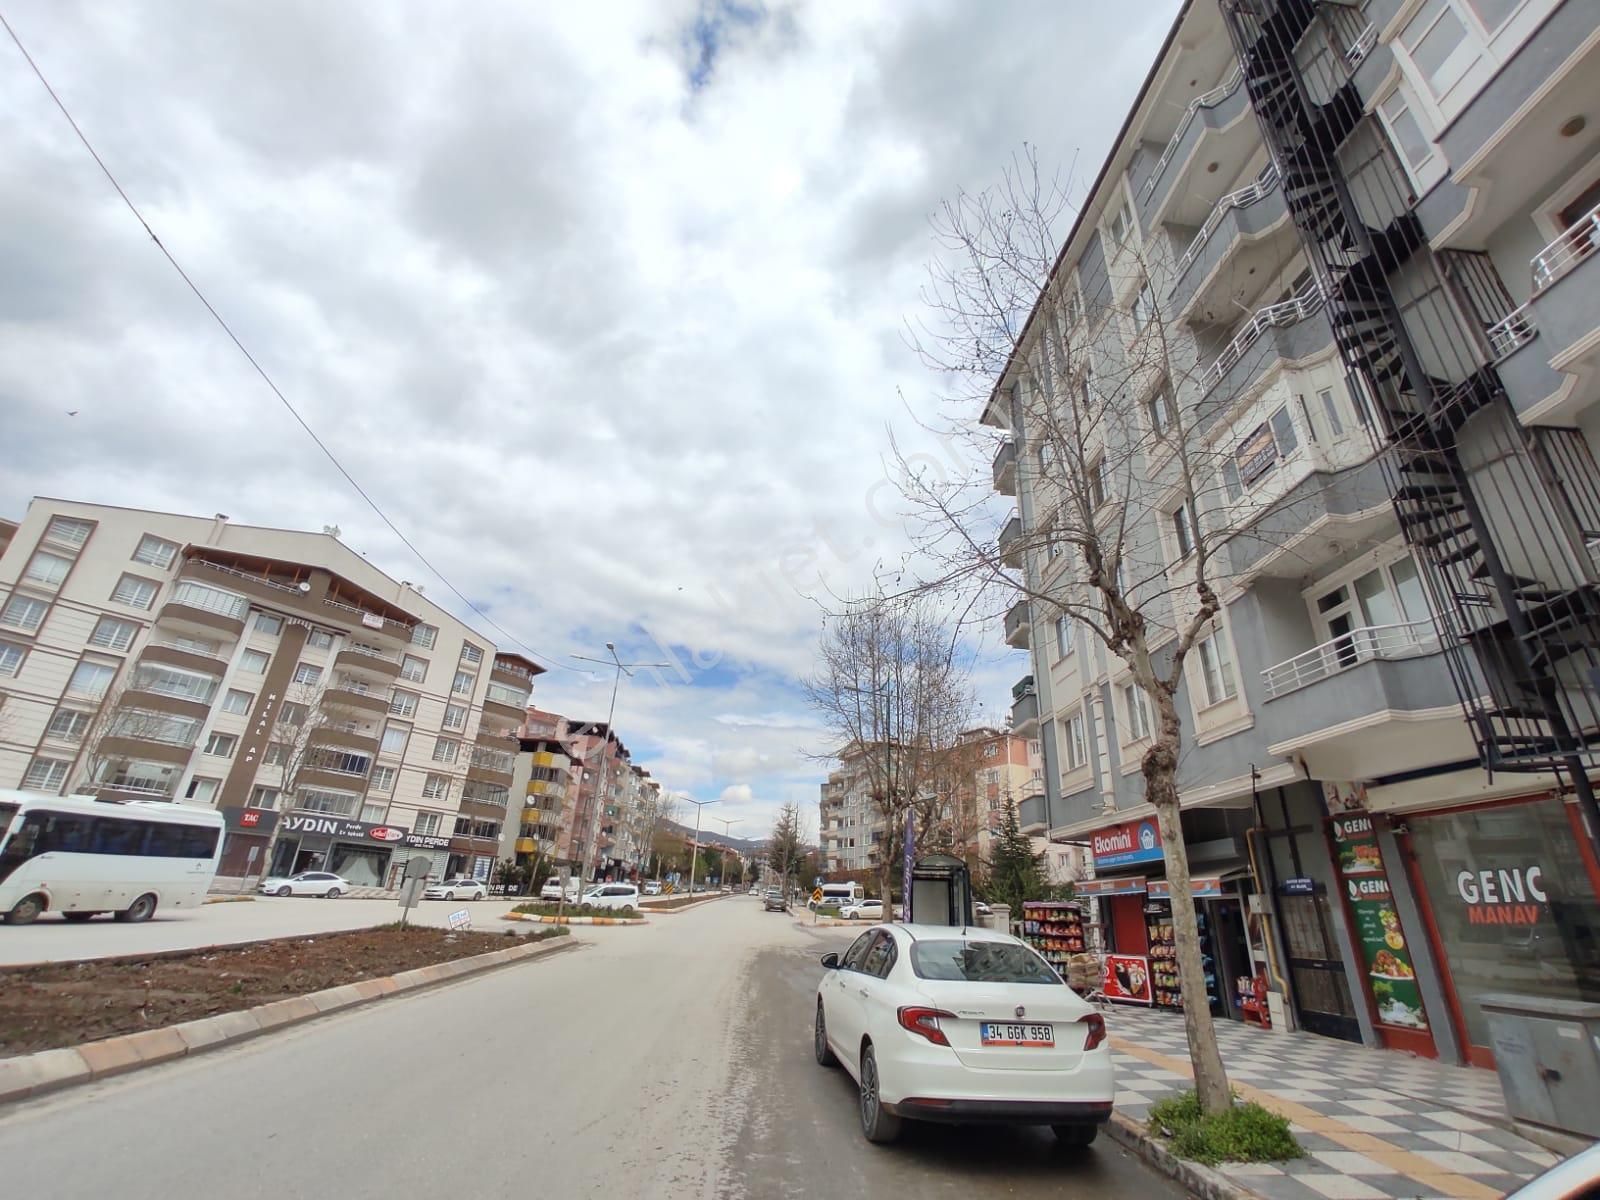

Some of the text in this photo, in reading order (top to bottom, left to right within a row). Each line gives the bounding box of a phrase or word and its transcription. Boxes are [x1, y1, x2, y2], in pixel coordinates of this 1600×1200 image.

[1094, 827, 1132, 854] Ekomini
[1467, 905, 1539, 925] MANAV
[988, 1025, 1051, 1041] 34 GGK 958
